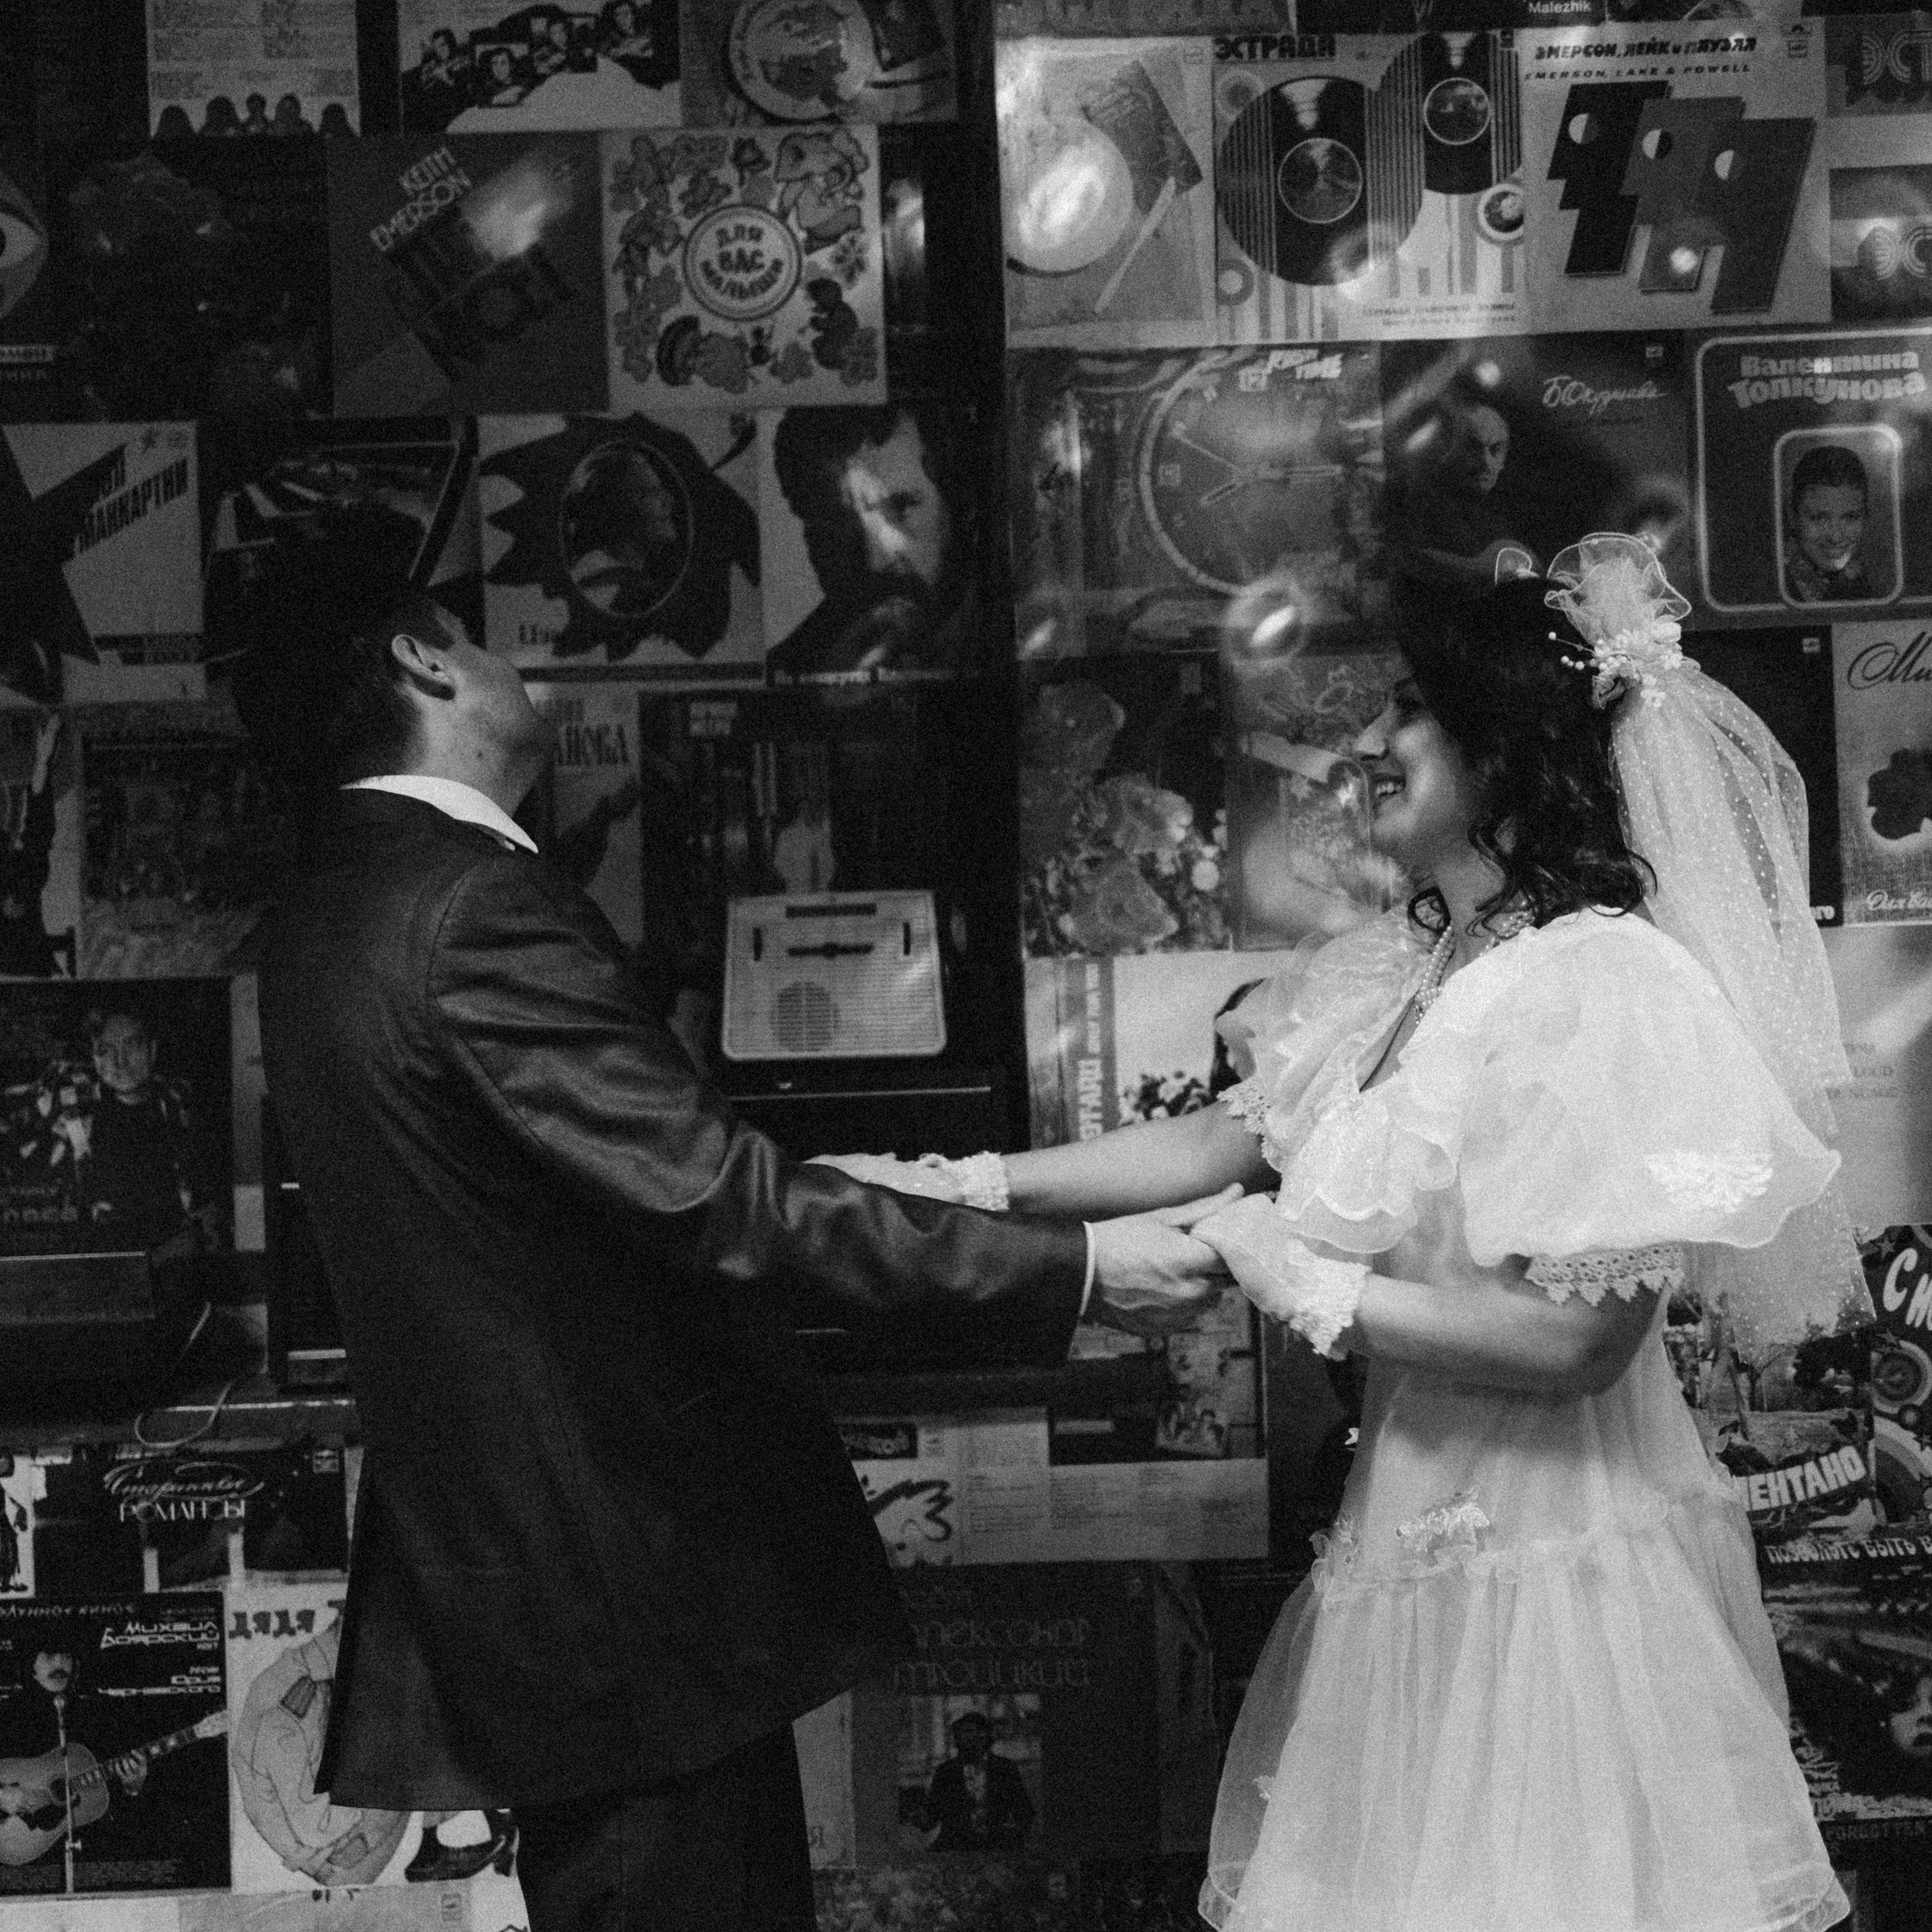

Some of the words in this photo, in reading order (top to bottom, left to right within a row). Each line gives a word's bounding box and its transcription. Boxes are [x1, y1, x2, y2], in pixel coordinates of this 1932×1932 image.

[1529, 2, 1591, 14] Malezhik
[1213, 35, 1337, 60] ЭСТРАДА
[1525, 70, 1606, 80] EMERSON
[1616, 67, 1658, 76] LAKE
[1684, 64, 1751, 74] POWELL
